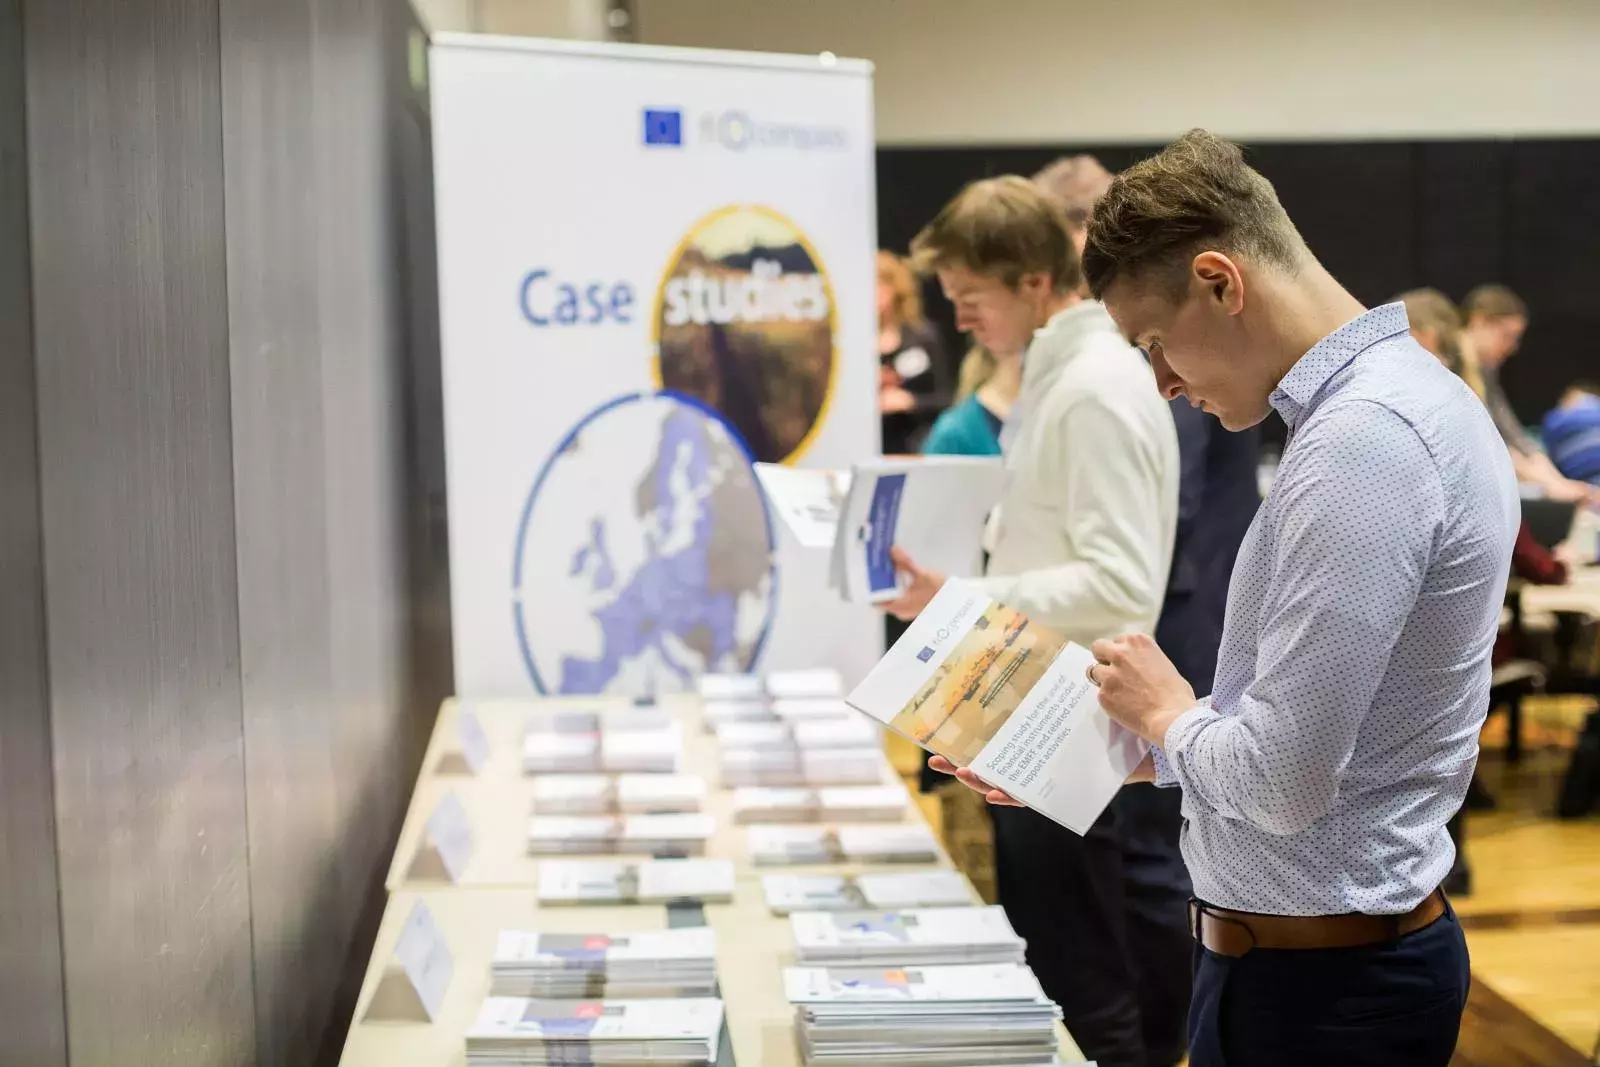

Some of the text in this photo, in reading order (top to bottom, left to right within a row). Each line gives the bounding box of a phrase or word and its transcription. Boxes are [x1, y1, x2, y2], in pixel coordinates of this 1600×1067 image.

[519, 258, 829, 326] Case studies
[985, 740, 1015, 769] Scoping
[1010, 720, 1030, 742] study
[1026, 708, 1040, 720] for
[1035, 696, 1050, 710] the
[996, 744, 1025, 775] financial
[1020, 702, 1059, 746] instruments
[1056, 681, 1076, 703] under
[1007, 768, 1022, 781] the
[1017, 748, 1037, 770] EMFF
[1036, 734, 1049, 750] and
[1046, 707, 1070, 735] related
[1019, 759, 1046, 788] support
[1041, 726, 1071, 760] activities
